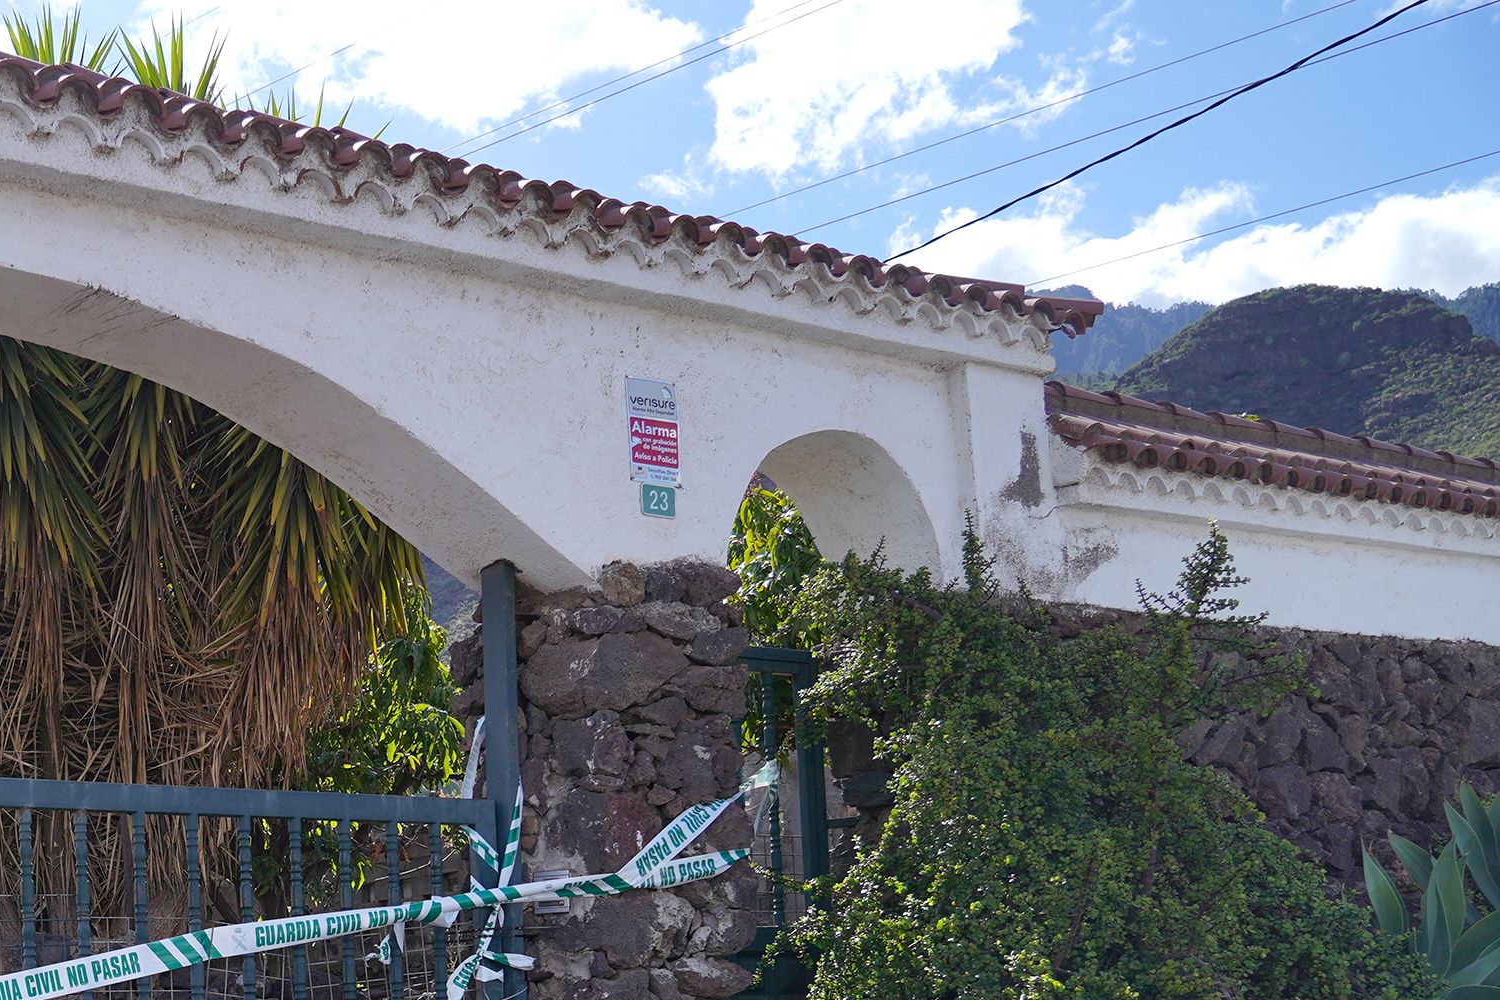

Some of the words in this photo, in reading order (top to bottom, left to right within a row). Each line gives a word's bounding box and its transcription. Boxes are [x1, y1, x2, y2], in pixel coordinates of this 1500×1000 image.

[630, 396, 676, 410] verisure
[631, 420, 677, 439] Alarma
[634, 451, 651, 461] Aviso
[657, 455, 677, 465] Policía
[649, 490, 668, 511] 23
[667, 824, 688, 848] NO
[636, 836, 672, 877] PASAR
[660, 864, 676, 886] NO
[678, 858, 717, 881] PASAR
[255, 918, 321, 948] GUARDIA
[326, 913, 363, 937] CIVIL
[368, 909, 389, 929] NO
[24, 969, 64, 998] CIVIL
[66, 963, 89, 988] NO
[91, 952, 141, 983] PASAR
